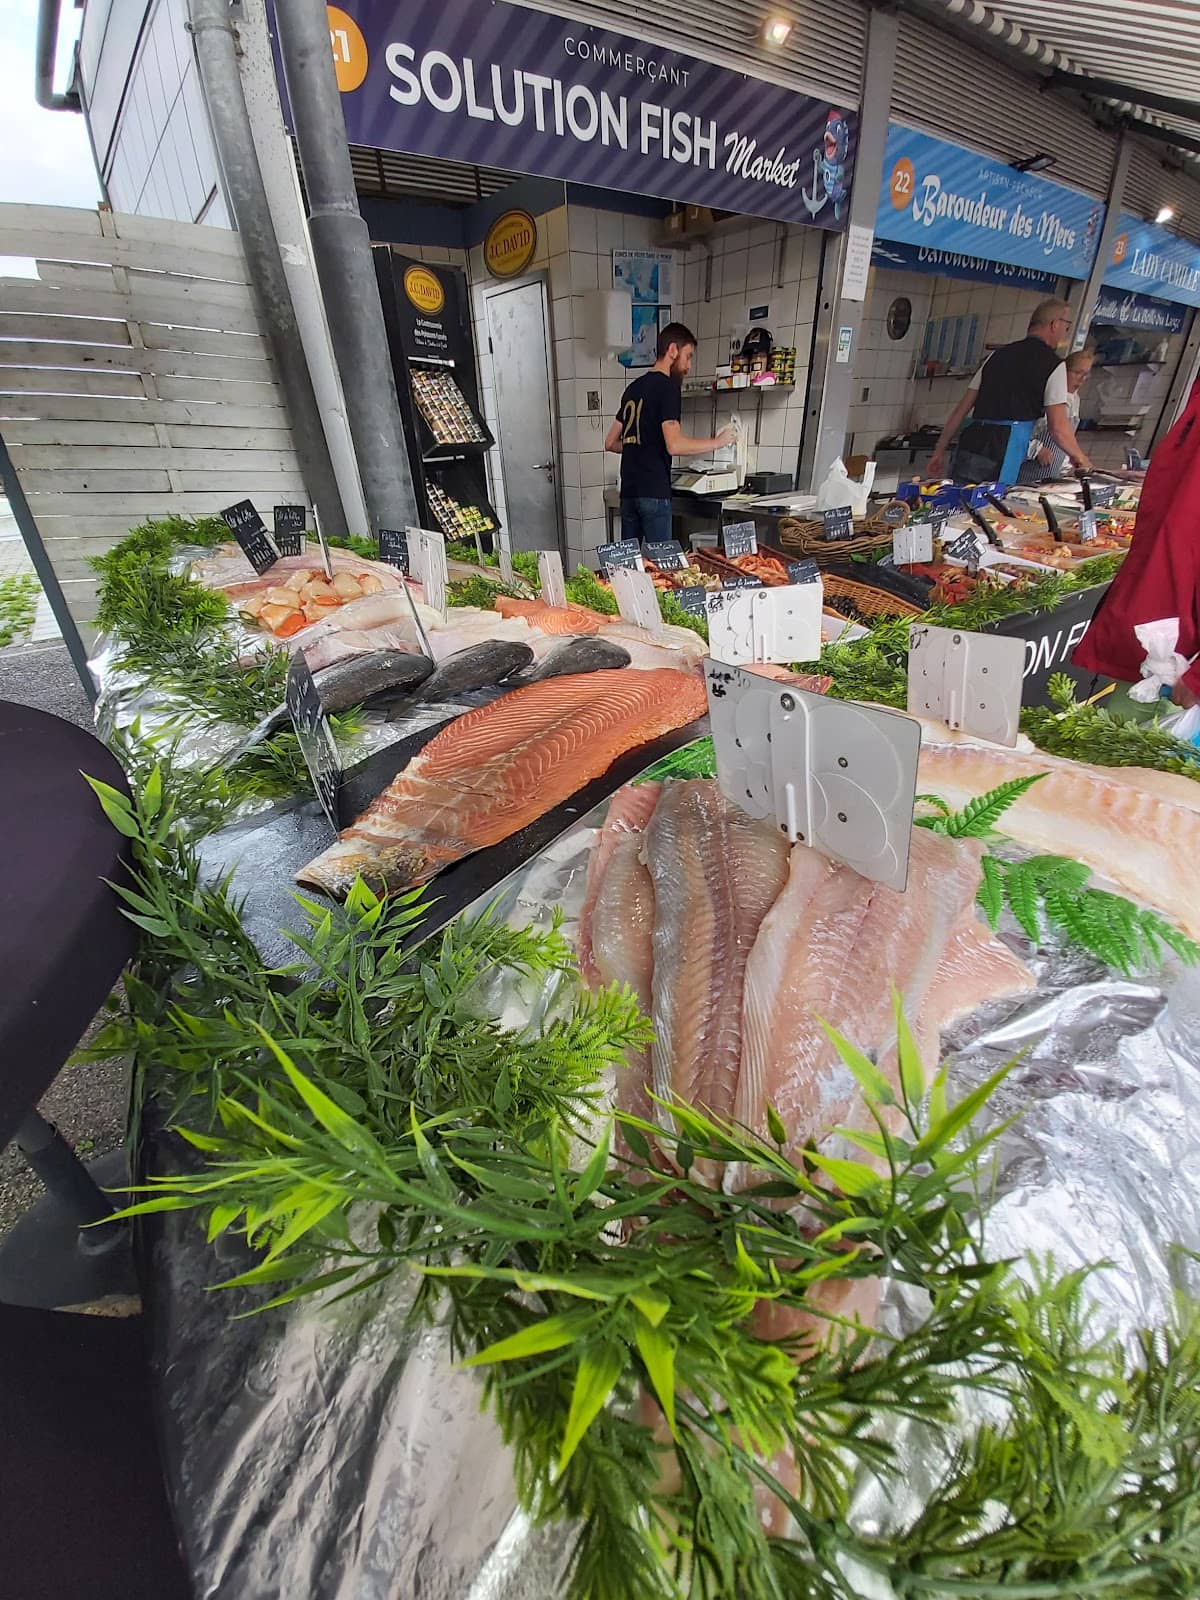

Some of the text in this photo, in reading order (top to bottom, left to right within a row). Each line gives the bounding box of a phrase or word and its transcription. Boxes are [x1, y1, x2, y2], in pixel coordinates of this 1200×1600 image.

[564, 36, 690, 88] COMMERÇANT
[385, 42, 800, 188] SOLUTION FISH Market
[894, 171, 910, 193] 22
[912, 174, 1076, 255] Baroudeur des Mers
[1130, 248, 1200, 292] LADY CAMILLE
[622, 398, 643, 445] 21
